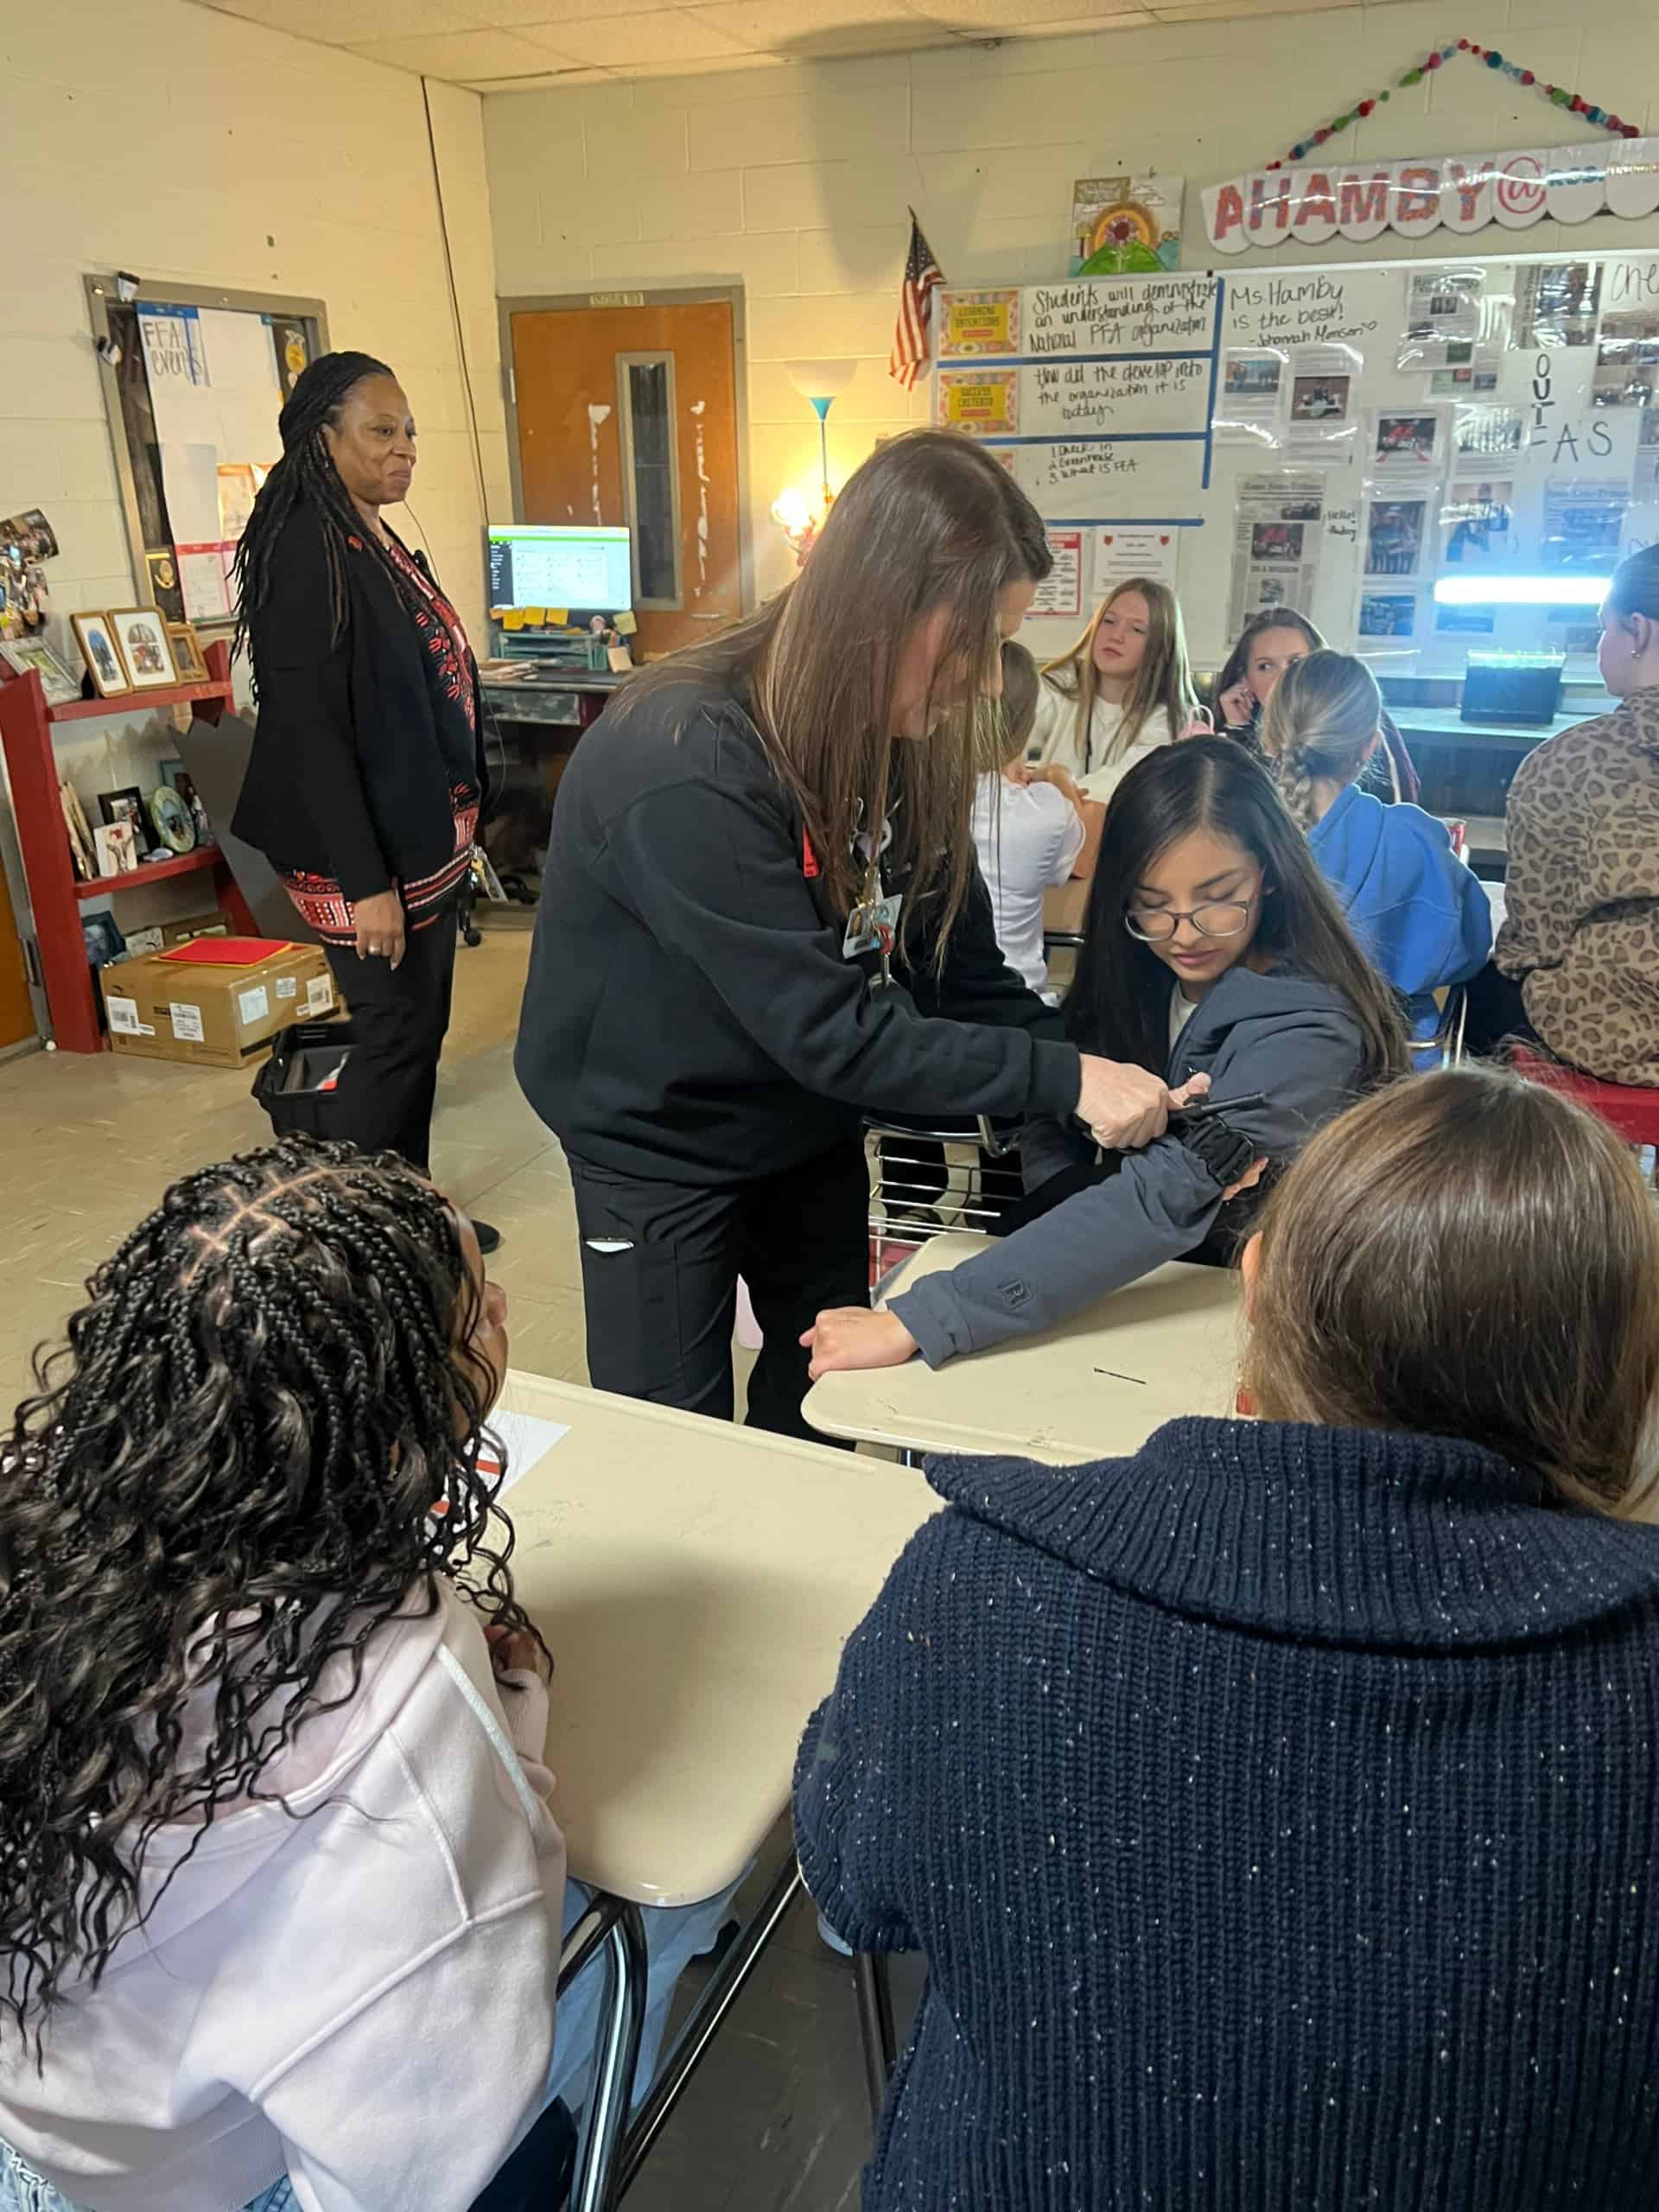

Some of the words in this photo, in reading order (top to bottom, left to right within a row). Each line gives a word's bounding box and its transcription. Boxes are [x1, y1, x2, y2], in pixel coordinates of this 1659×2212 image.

[1033, 283, 1098, 314] Students
[1109, 286, 1133, 302] will
[1268, 275, 1344, 307] Hamby
[1036, 316, 1052, 327] an
[1063, 300, 1159, 323] understanding
[1185, 296, 1205, 312] the
[1258, 311, 1292, 330] the
[1029, 330, 1077, 353] National
[1132, 315, 1206, 347] organization
[1122, 360, 1173, 381] develop
[1037, 391, 1059, 404] the
[1068, 384, 1148, 404] organization
[1154, 383, 1168, 394] it
[1173, 379, 1186, 391] is
